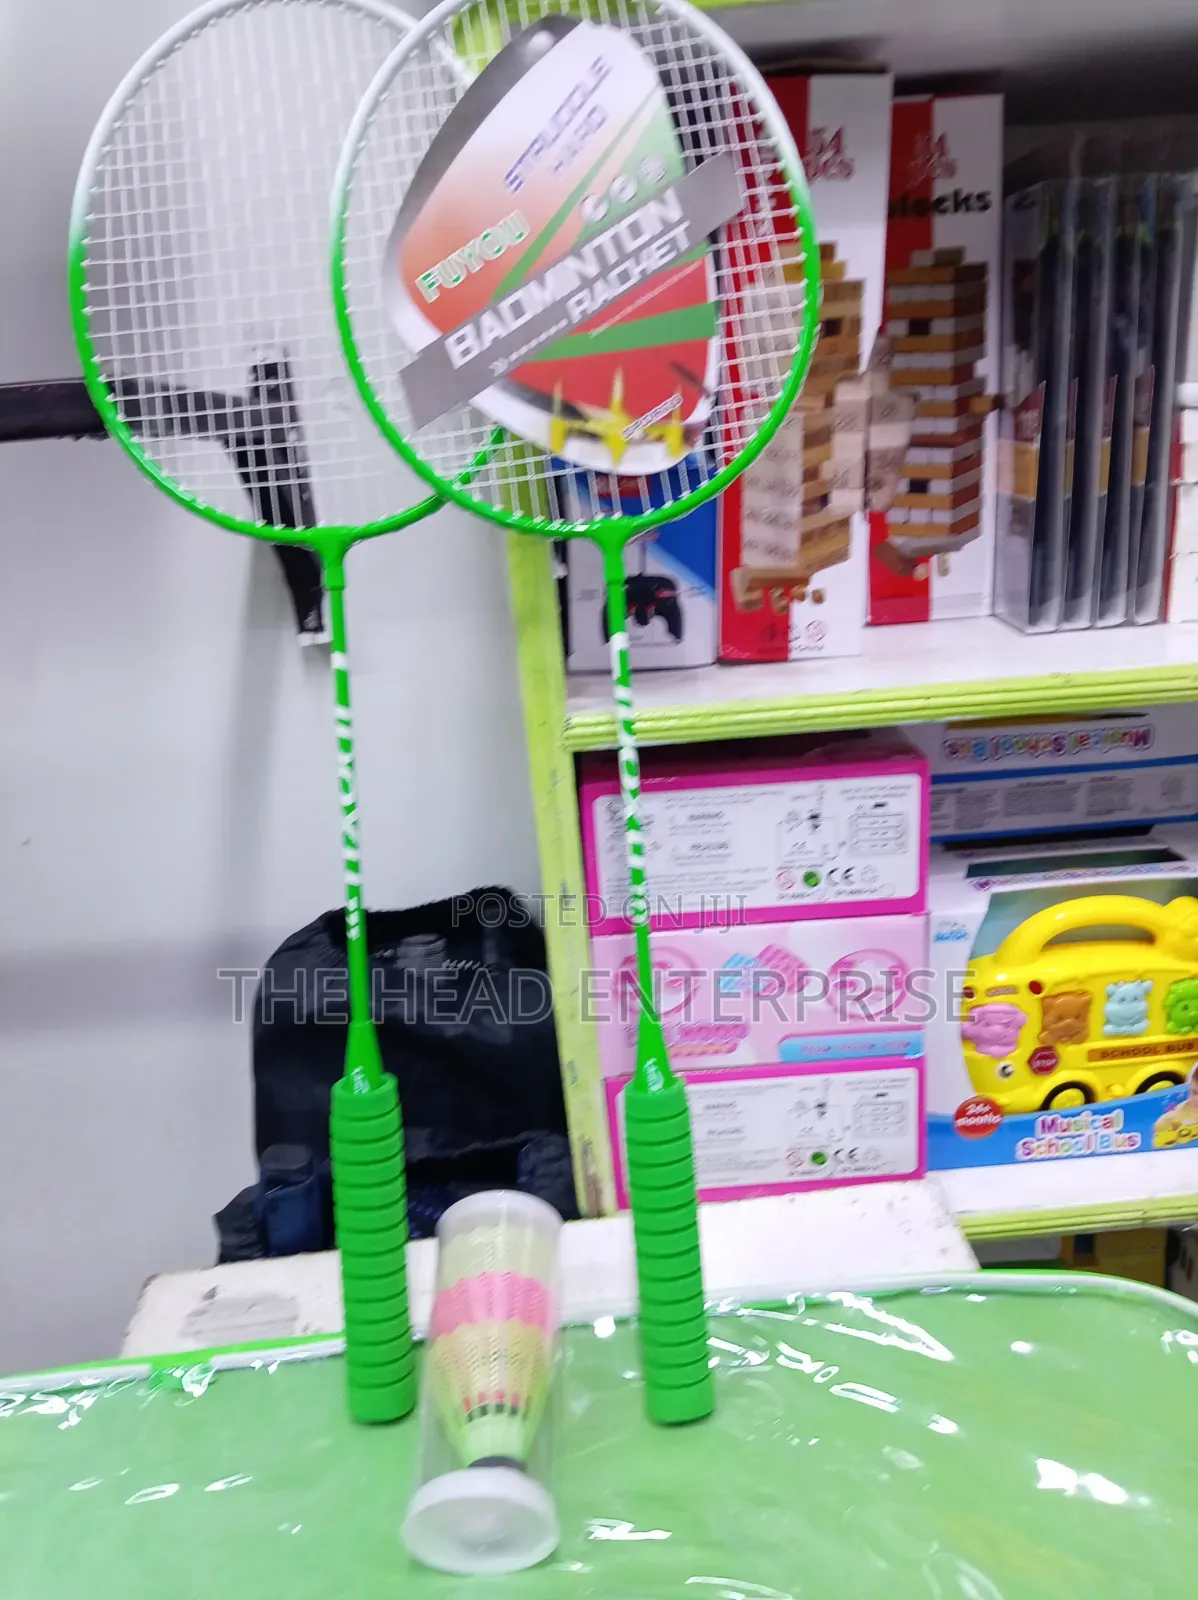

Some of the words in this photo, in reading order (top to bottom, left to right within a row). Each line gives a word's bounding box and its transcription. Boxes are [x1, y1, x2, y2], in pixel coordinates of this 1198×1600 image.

[415, 209, 531, 303] FUYOU
[444, 187, 684, 369] BADMINTON
[1016, 1134, 1096, 1160] School
[1097, 1131, 1141, 1154] Bus
[1036, 1110, 1124, 1138] Musical
